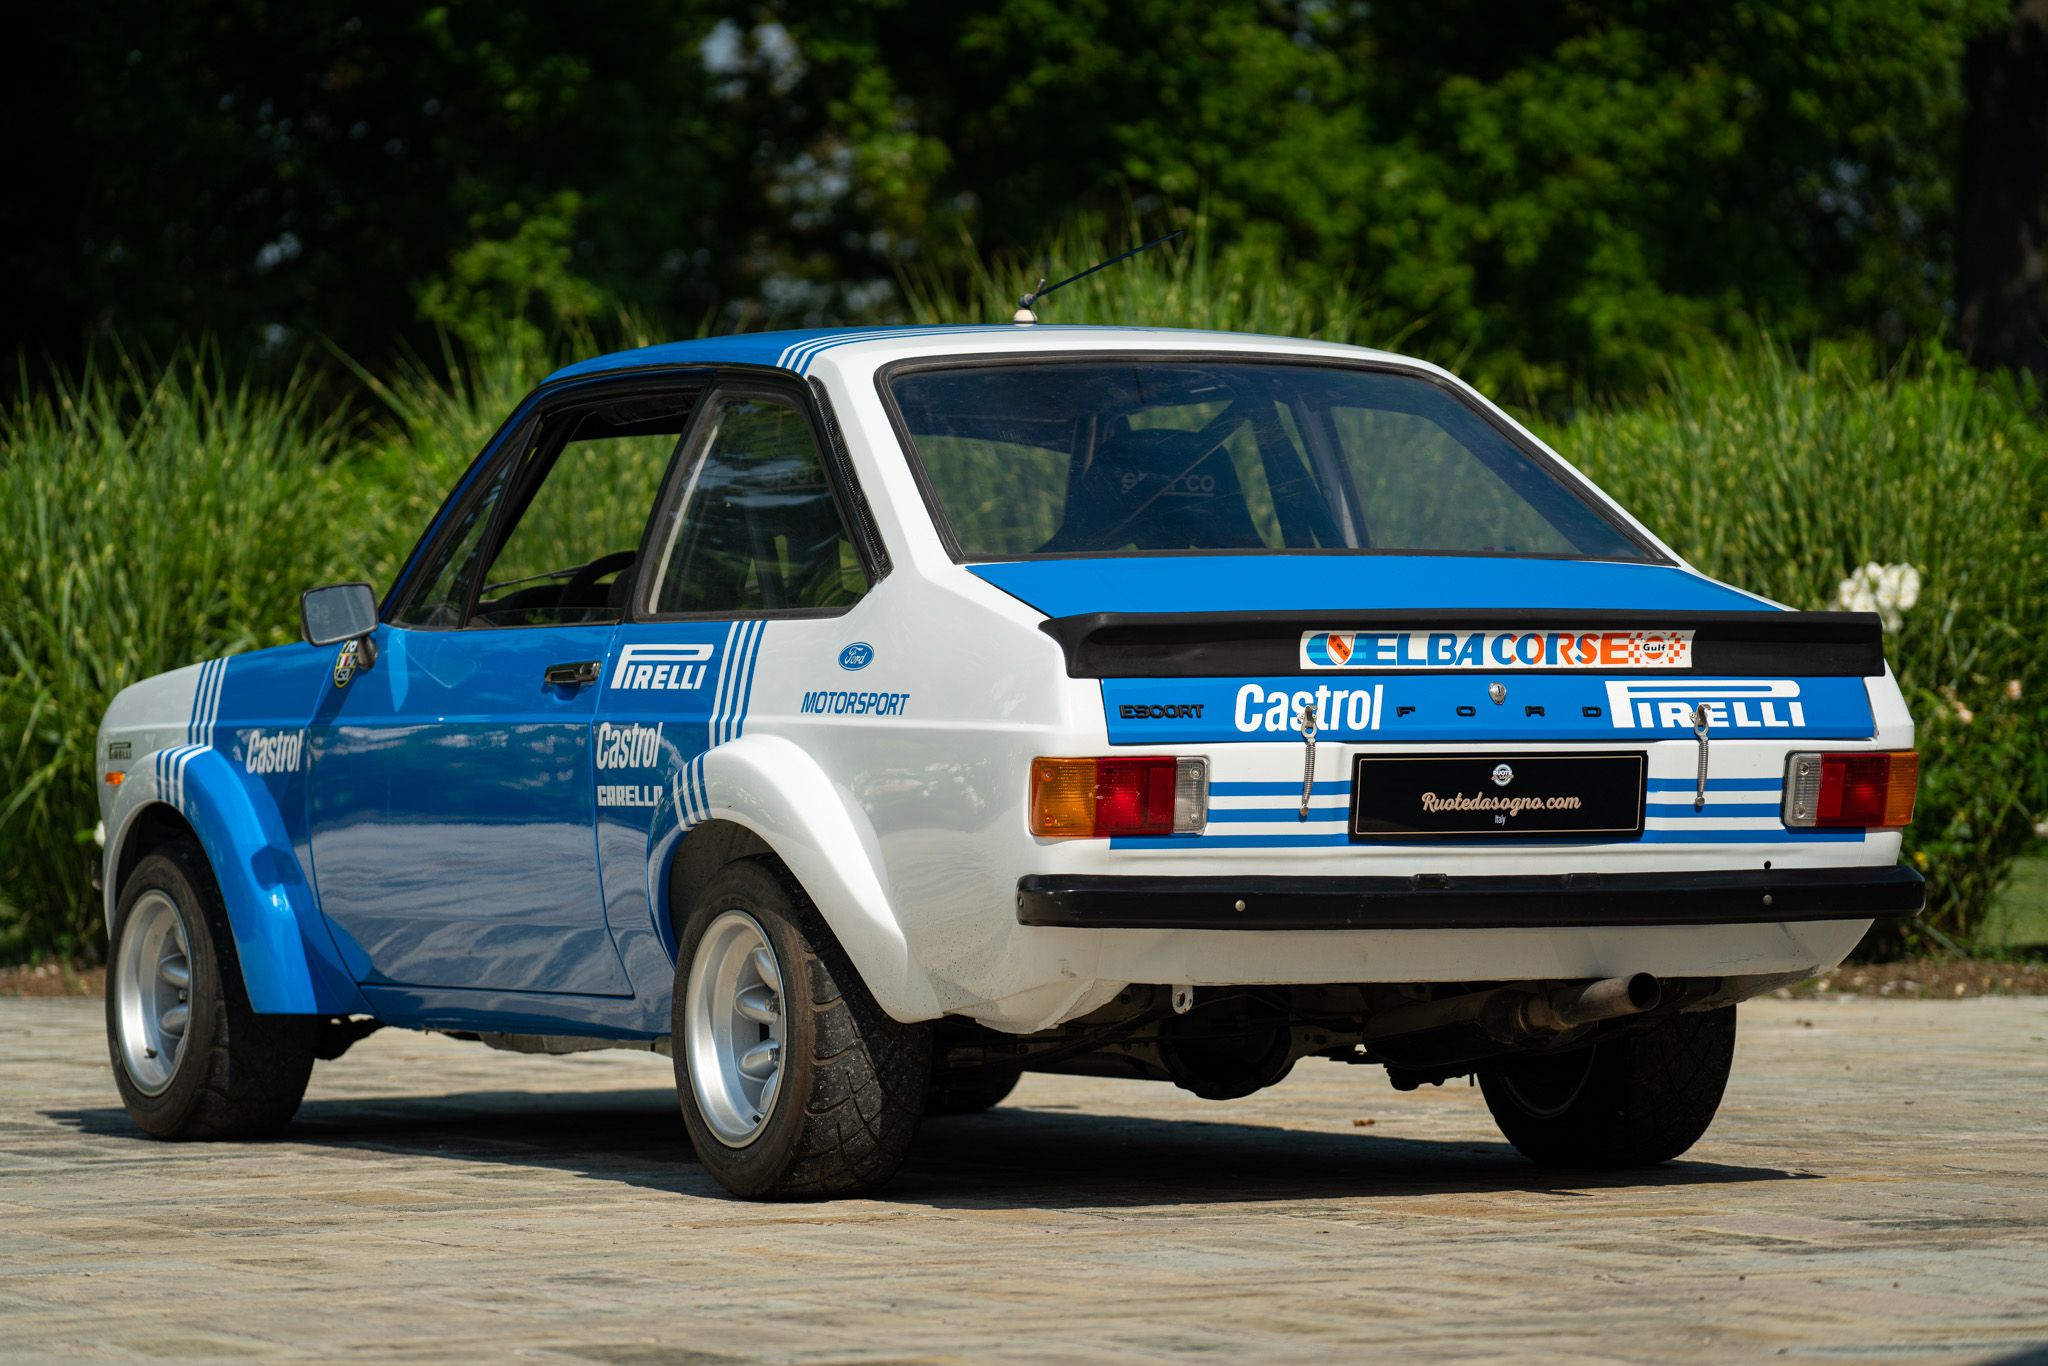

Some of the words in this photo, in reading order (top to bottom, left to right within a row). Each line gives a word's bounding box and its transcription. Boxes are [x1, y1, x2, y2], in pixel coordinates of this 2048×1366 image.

[1357, 632, 1486, 666] ELBA
[1491, 632, 1631, 666] CORSE
[1643, 643, 1666, 652] Gulf
[610, 644, 714, 690] PIRELLI
[800, 691, 910, 716] MOTORSPORT
[1118, 704, 1204, 719] ESCORT
[1234, 683, 1384, 733] Castrol
[1604, 679, 1806, 728] PIRELLI
[246, 728, 304, 775] Castrol
[596, 721, 664, 770] Castrol
[597, 785, 664, 807] CARELLO
[1421, 791, 1582, 816] Ruotedasogno.com
[1494, 813, 1507, 826] Italy
